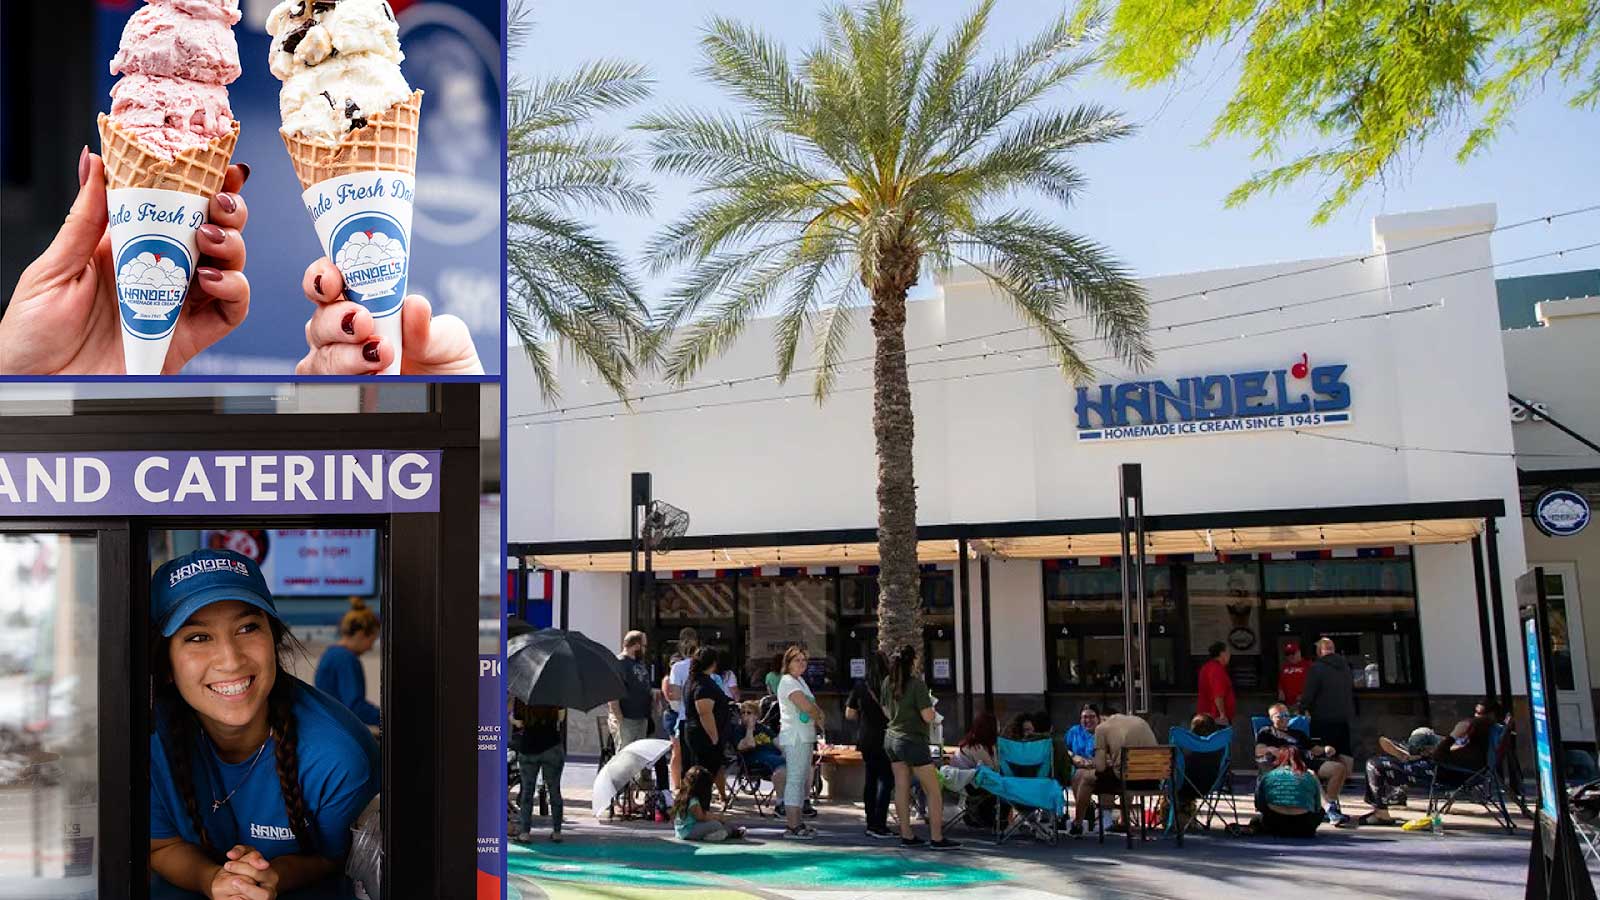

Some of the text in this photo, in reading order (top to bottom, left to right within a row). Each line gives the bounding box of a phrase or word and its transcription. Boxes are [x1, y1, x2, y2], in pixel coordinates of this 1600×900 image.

[336, 177, 385, 205] Fresh
[138, 202, 185, 225] Fresh
[345, 262, 402, 284] HANDEL'S
[124, 287, 181, 301] HANDEL'S
[1074, 353, 1351, 428] HANDEL'S
[1104, 414, 1321, 439] HOMEMADE ICE CREAM SINCE 1945
[0, 453, 433, 503] AND CATERING
[169, 558, 249, 585] HANDEL'S
